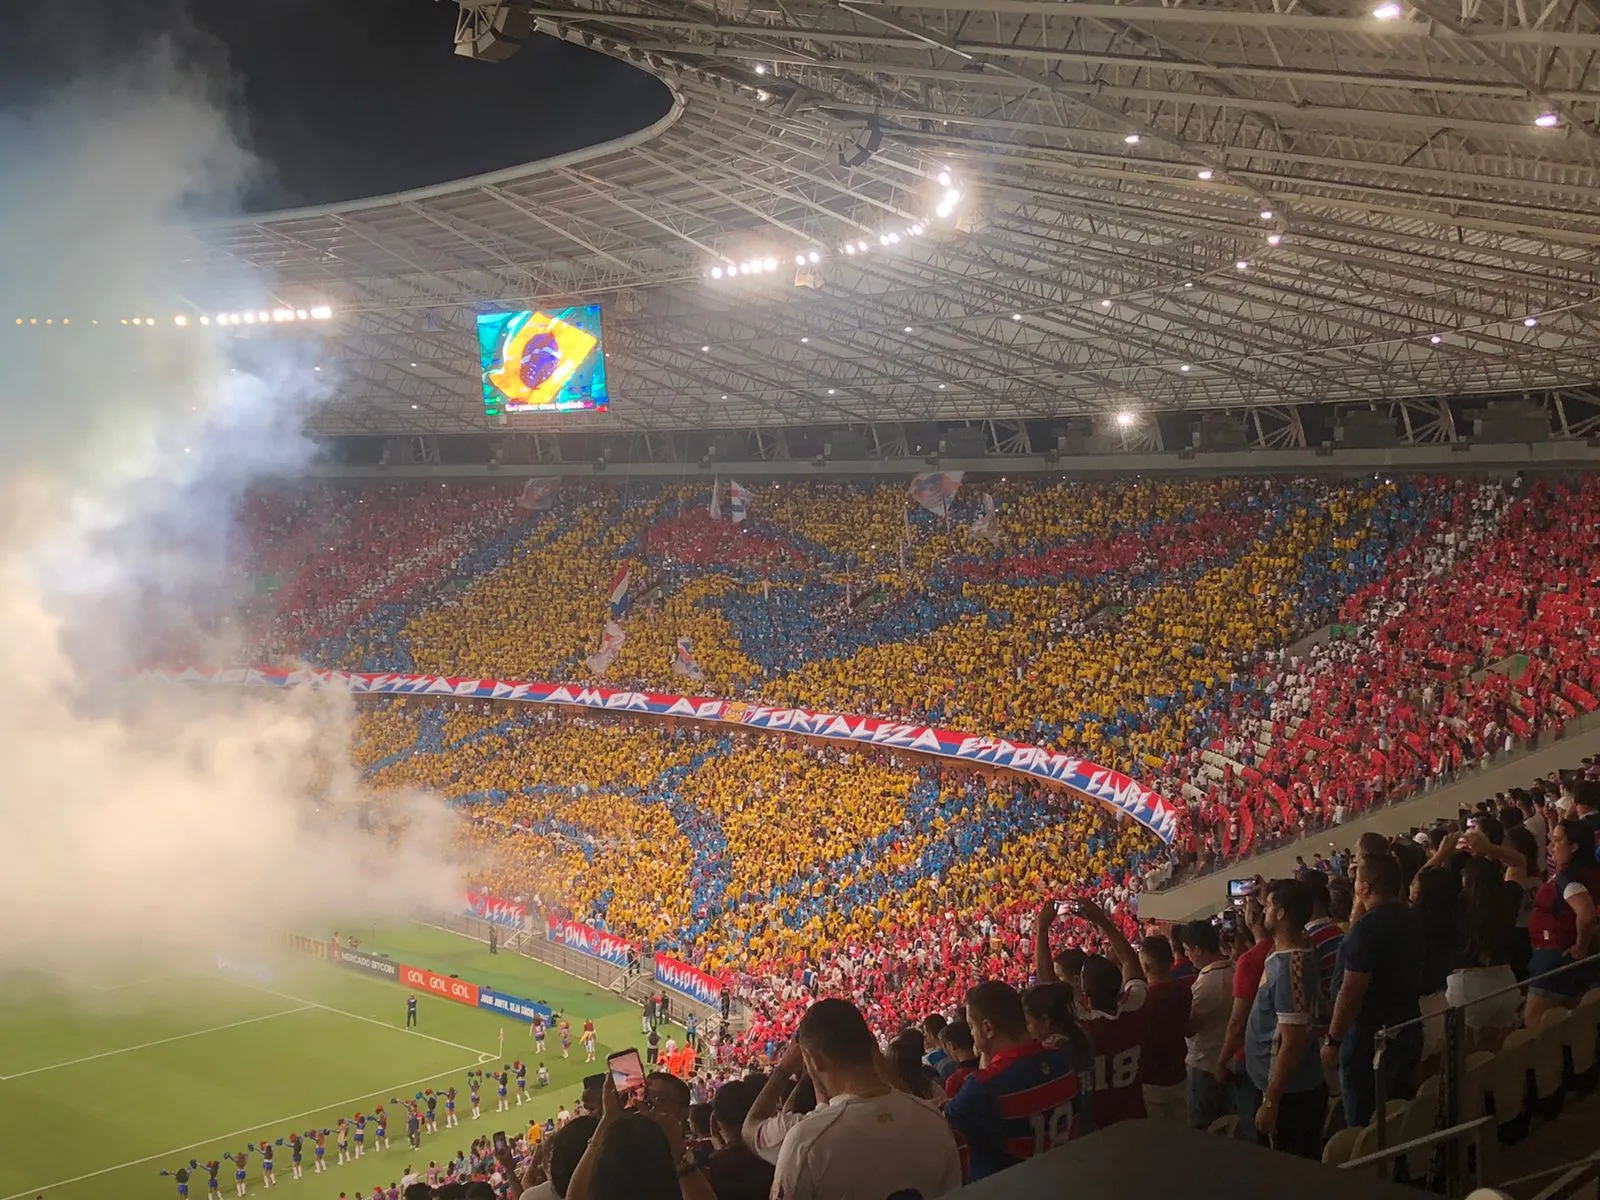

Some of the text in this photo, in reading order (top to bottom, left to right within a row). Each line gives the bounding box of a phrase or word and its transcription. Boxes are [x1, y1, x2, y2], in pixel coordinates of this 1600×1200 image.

[491, 681, 534, 699] DE
[543, 686, 650, 711] AMOR
[664, 696, 724, 717] AO
[748, 706, 942, 751] FORTALEZA
[956, 735, 1082, 780] ESPORTE
[1084, 770, 1152, 815] CLUBE
[341, 951, 396, 975] MERCADO BITCOIN
[600, 938, 632, 964] OEST
[407, 969, 470, 999] GOL GOL GOL
[1094, 1044, 1142, 1092] 18
